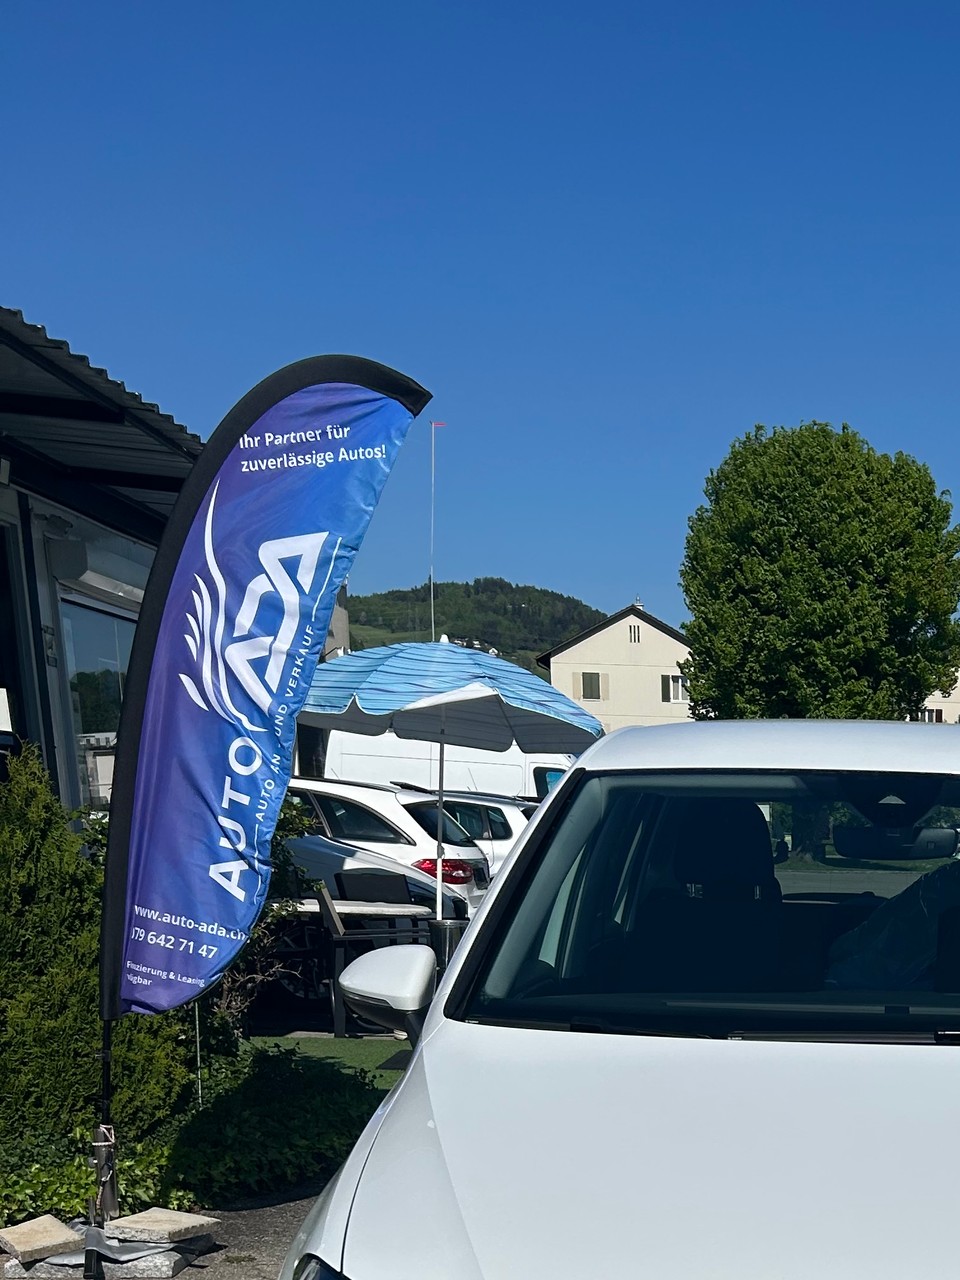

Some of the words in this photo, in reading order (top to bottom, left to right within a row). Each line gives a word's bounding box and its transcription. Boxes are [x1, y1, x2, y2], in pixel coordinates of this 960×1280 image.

[239, 434, 261, 449] Ihr
[264, 429, 322, 447] Partner
[326, 424, 351, 440] für
[240, 450, 334, 473] zuverlässige
[338, 444, 387, 462] Autos!
[257, 778, 275, 821] AUTO
[274, 704, 288, 737] UND
[285, 625, 316, 698] VERKAUF
[208, 736, 263, 903] AUTO
[147, 931, 175, 949] 642
[178, 938, 194, 954] 71
[198, 944, 218, 959] 47
